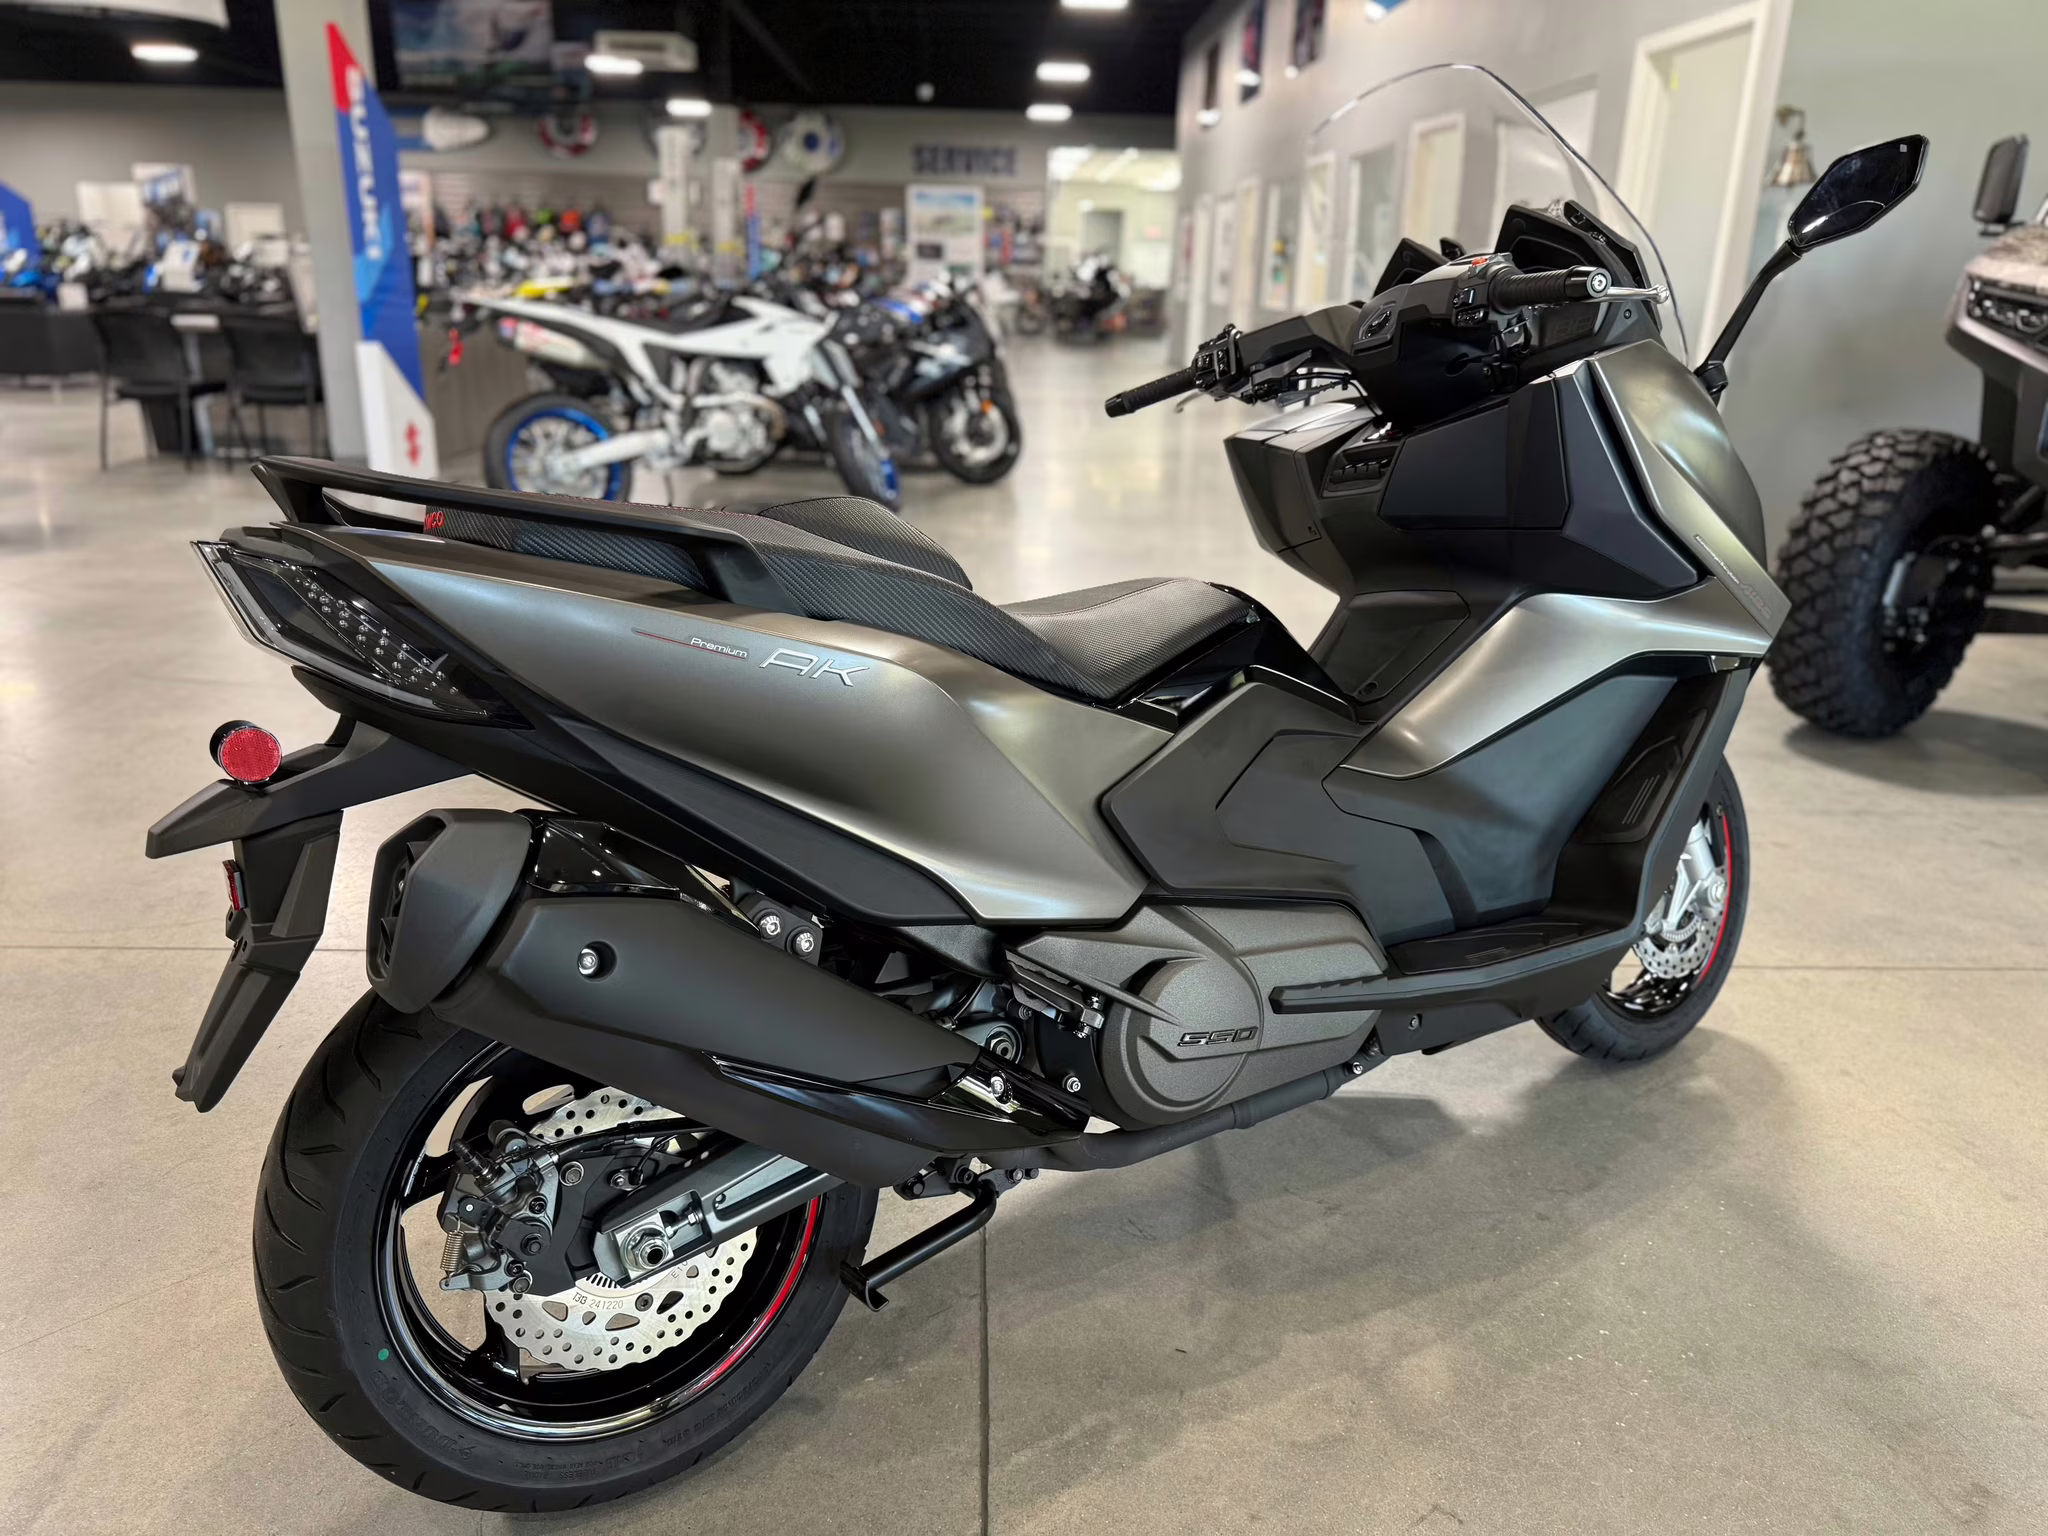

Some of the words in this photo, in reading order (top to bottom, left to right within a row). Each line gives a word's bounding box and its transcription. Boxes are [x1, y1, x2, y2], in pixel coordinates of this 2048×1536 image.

[912, 146, 1015, 176] SERVICE
[690, 637, 748, 658] Premium
[759, 647, 870, 687] AK
[1177, 1026, 1258, 1047] 550
[588, 1299, 625, 1310] 241220
